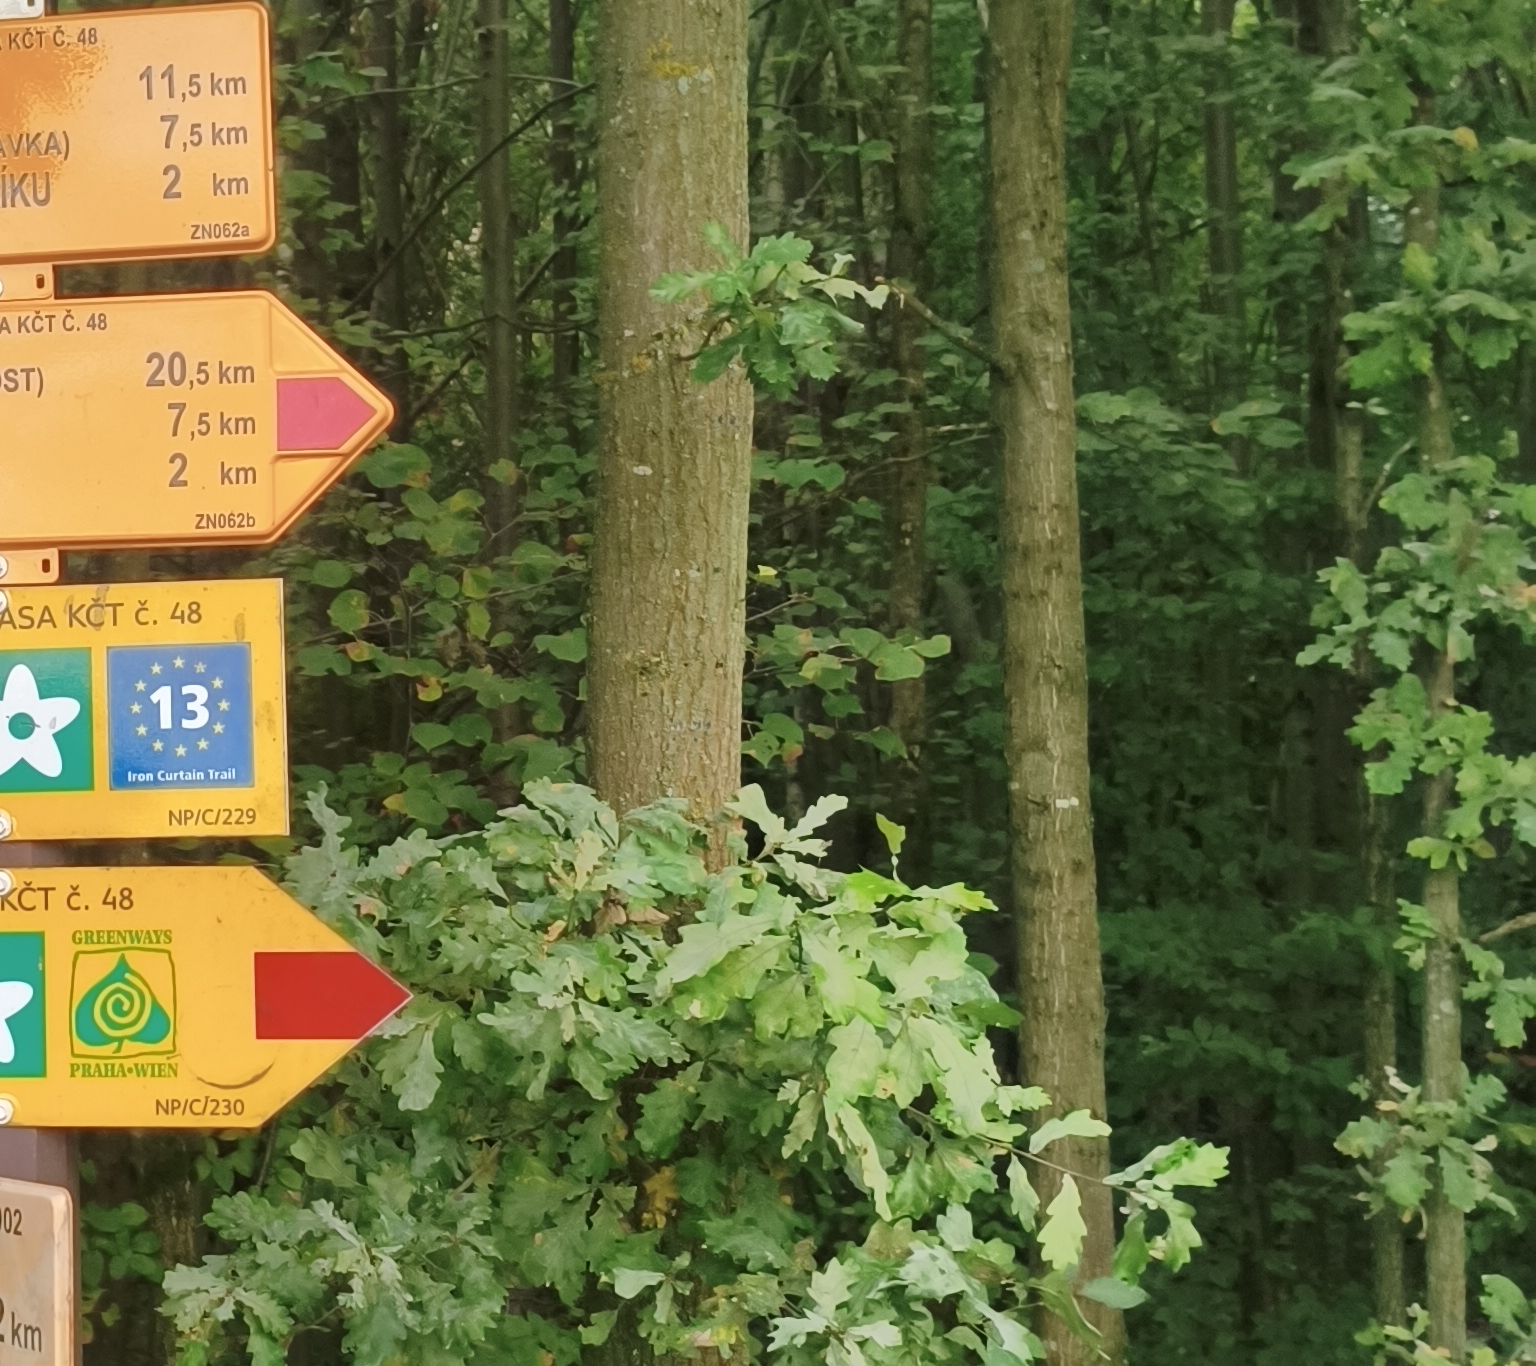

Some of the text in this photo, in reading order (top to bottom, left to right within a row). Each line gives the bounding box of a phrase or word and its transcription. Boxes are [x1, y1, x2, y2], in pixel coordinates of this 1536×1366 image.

[7, 29, 46, 52] KČT
[52, 26, 70, 50] Č.
[77, 27, 98, 47] 48
[139, 64, 201, 101] 11,5
[211, 70, 247, 97] km
[160, 115, 201, 152] 7,5
[212, 120, 248, 148] km
[162, 164, 182, 199] 2
[212, 171, 249, 197] km
[190, 223, 250, 241] ZN062a
[16, 312, 57, 335] KČT
[63, 310, 80, 332] Č.
[86, 313, 107, 332] 48
[145, 352, 209, 388] 20,5
[218, 359, 255, 385] km
[168, 402, 210, 440] 7,5
[219, 411, 256, 436] km
[168, 454, 188, 488] 2
[220, 460, 256, 485] km
[195, 511, 255, 531] ZN062b
[68, 597, 124, 628] KČT
[135, 603, 158, 627] č.
[171, 601, 202, 624] 48
[149, 683, 209, 730] 13
[127, 766, 236, 783] Iron Curtain Trail
[168, 807, 256, 828] NP/C/229
[1, 885, 55, 911] KČT
[66, 886, 92, 911] č.
[101, 888, 134, 910] 48
[72, 929, 172, 946] GREENWAYS
[155, 1097, 244, 1118] NP/C/230
[11, 1311, 42, 1353] km
